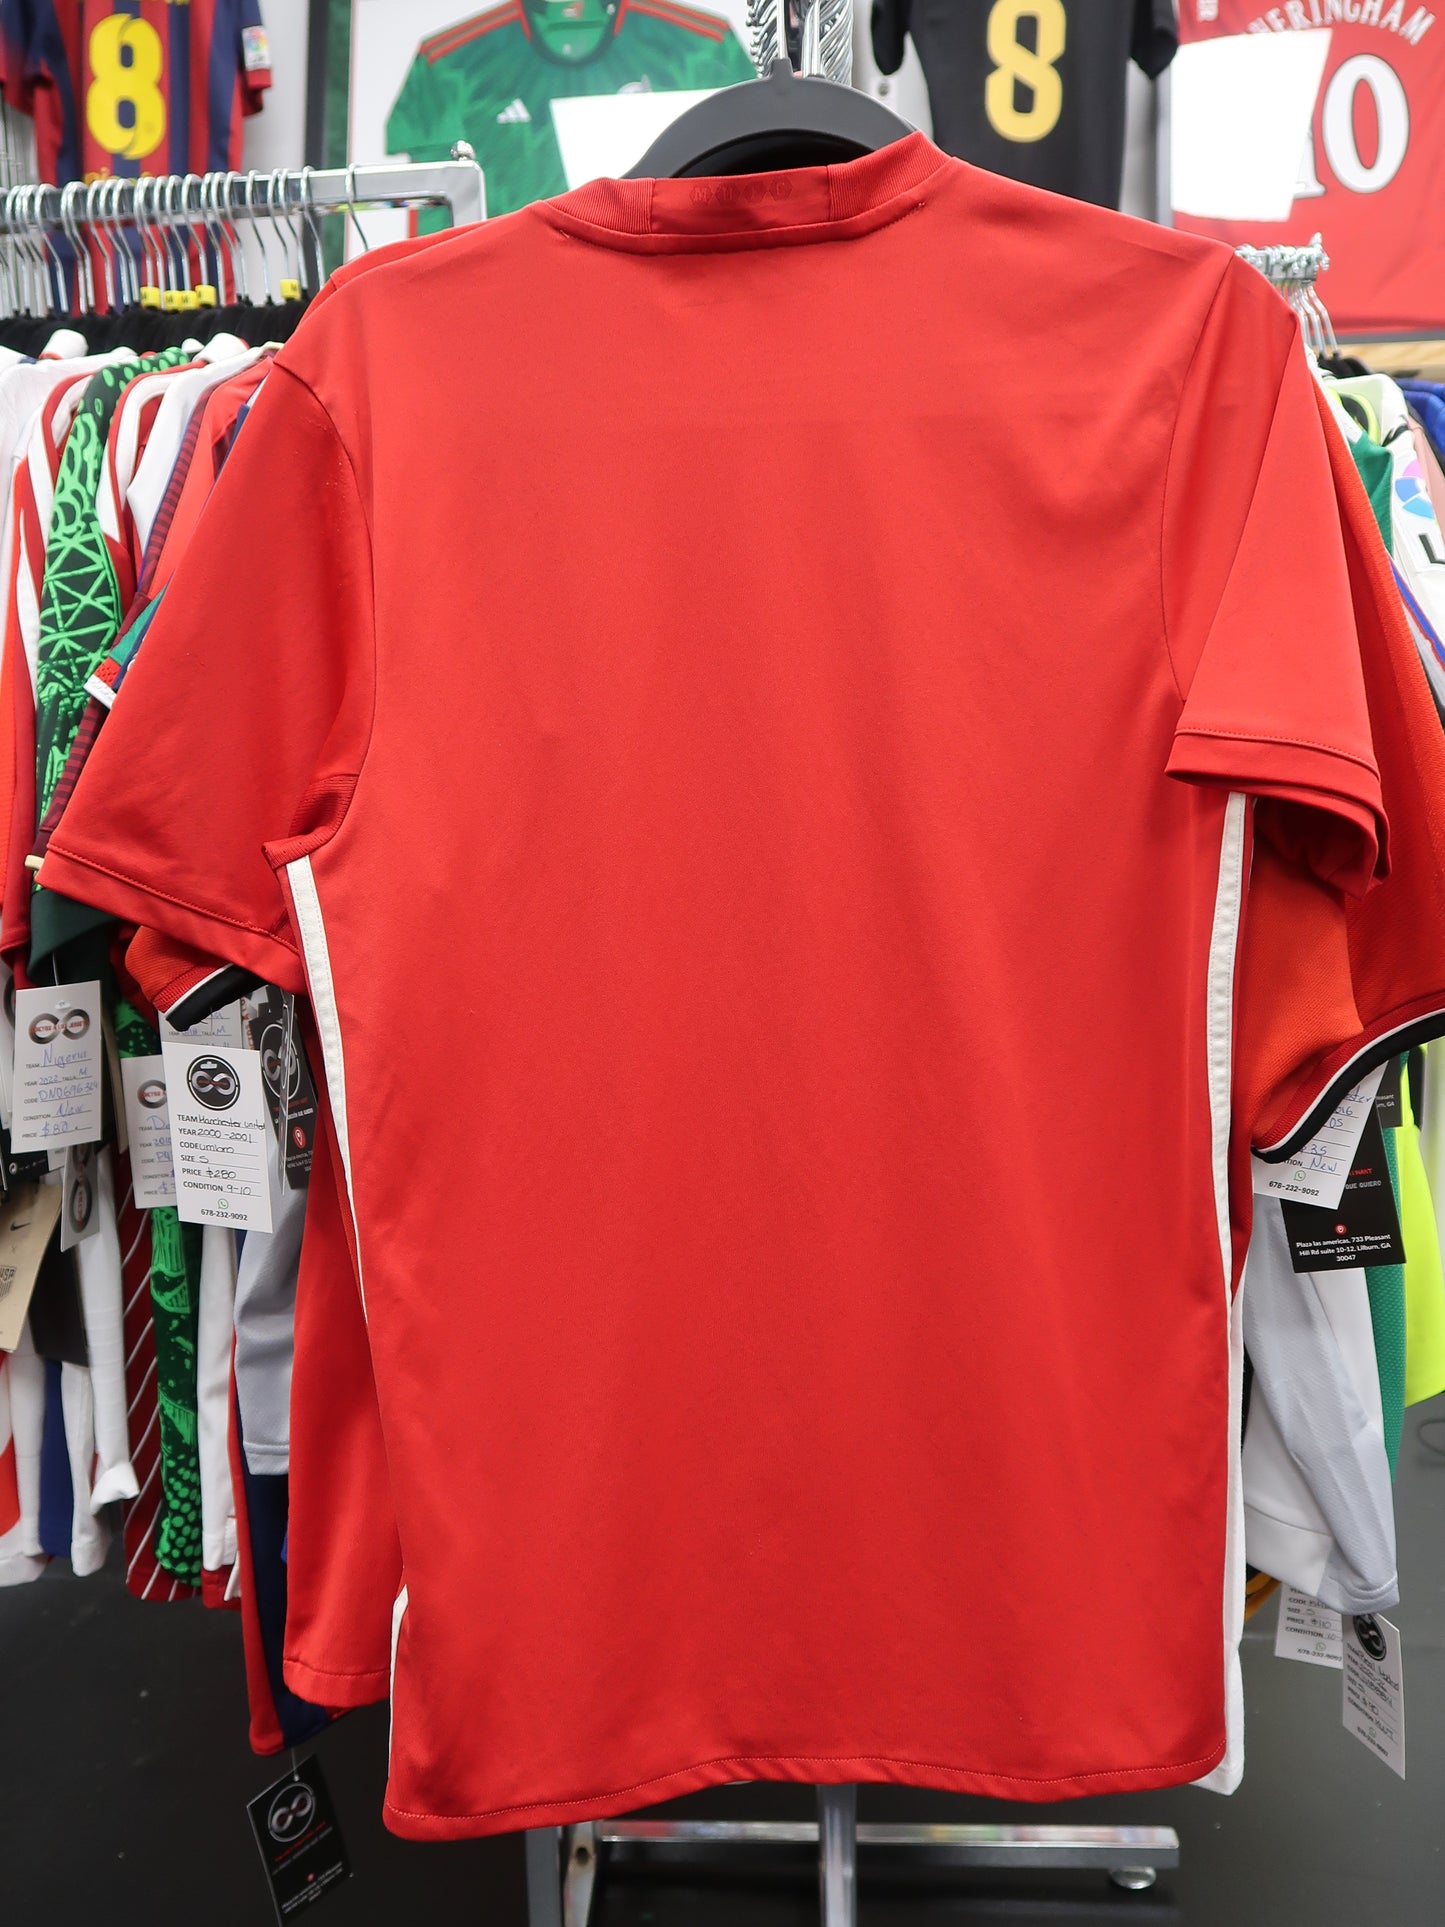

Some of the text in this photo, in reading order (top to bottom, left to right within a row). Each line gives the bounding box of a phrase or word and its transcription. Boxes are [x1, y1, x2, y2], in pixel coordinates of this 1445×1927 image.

[985, 0, 1066, 143] 8
[86, 13, 166, 160] 8
[177, 1114, 198, 1123] TEAM
[178, 1127, 197, 1136] YEAR
[197, 1128, 222, 1139] 2000
[180, 1141, 199, 1150] CODE
[180, 1154, 209, 1164] SIZE S
[1310, 1156, 1338, 1172] New
[182, 1167, 202, 1177] PRICE
[183, 1181, 252, 1196] CONDITION 9-10
[1268, 1180, 1320, 1197] 678-232-9092
[1345, 1180, 1382, 1190] QUE QUIERO
[200, 1209, 248, 1221] 678-232-9092
[1320, 1247, 1335, 1255] suite
[1336, 1254, 1356, 1262] 30047
[1285, 1626, 1324, 1638] CONDITION
